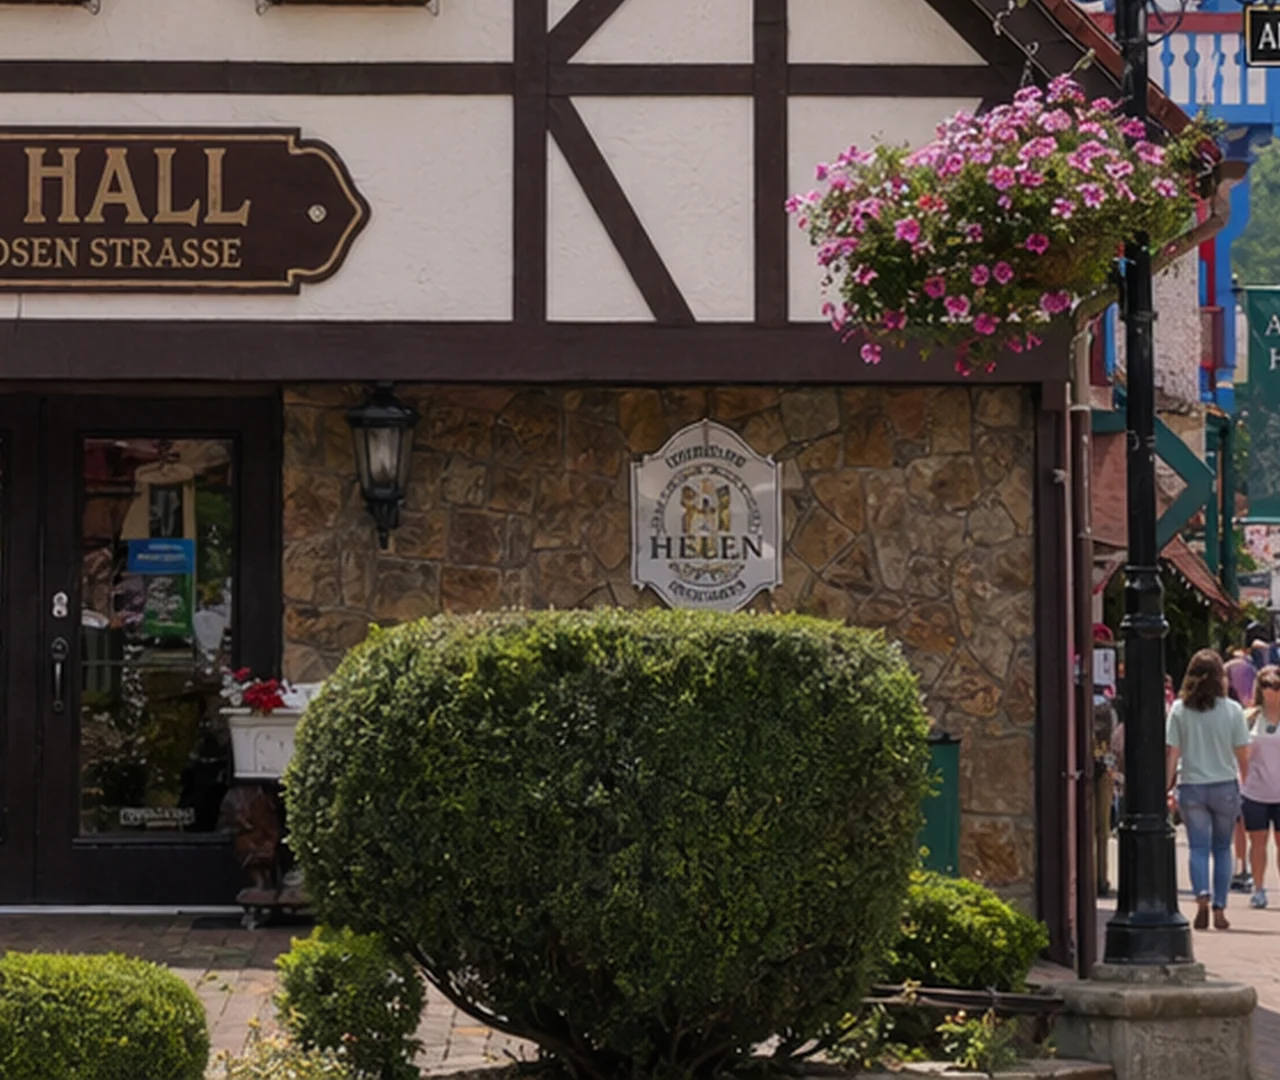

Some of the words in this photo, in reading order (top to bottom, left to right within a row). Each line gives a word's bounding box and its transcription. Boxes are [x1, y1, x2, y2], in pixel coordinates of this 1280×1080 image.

[23, 147, 250, 226] HALL
[89, 238, 242, 268] STRASSE
[650, 535, 763, 560] HELEN
